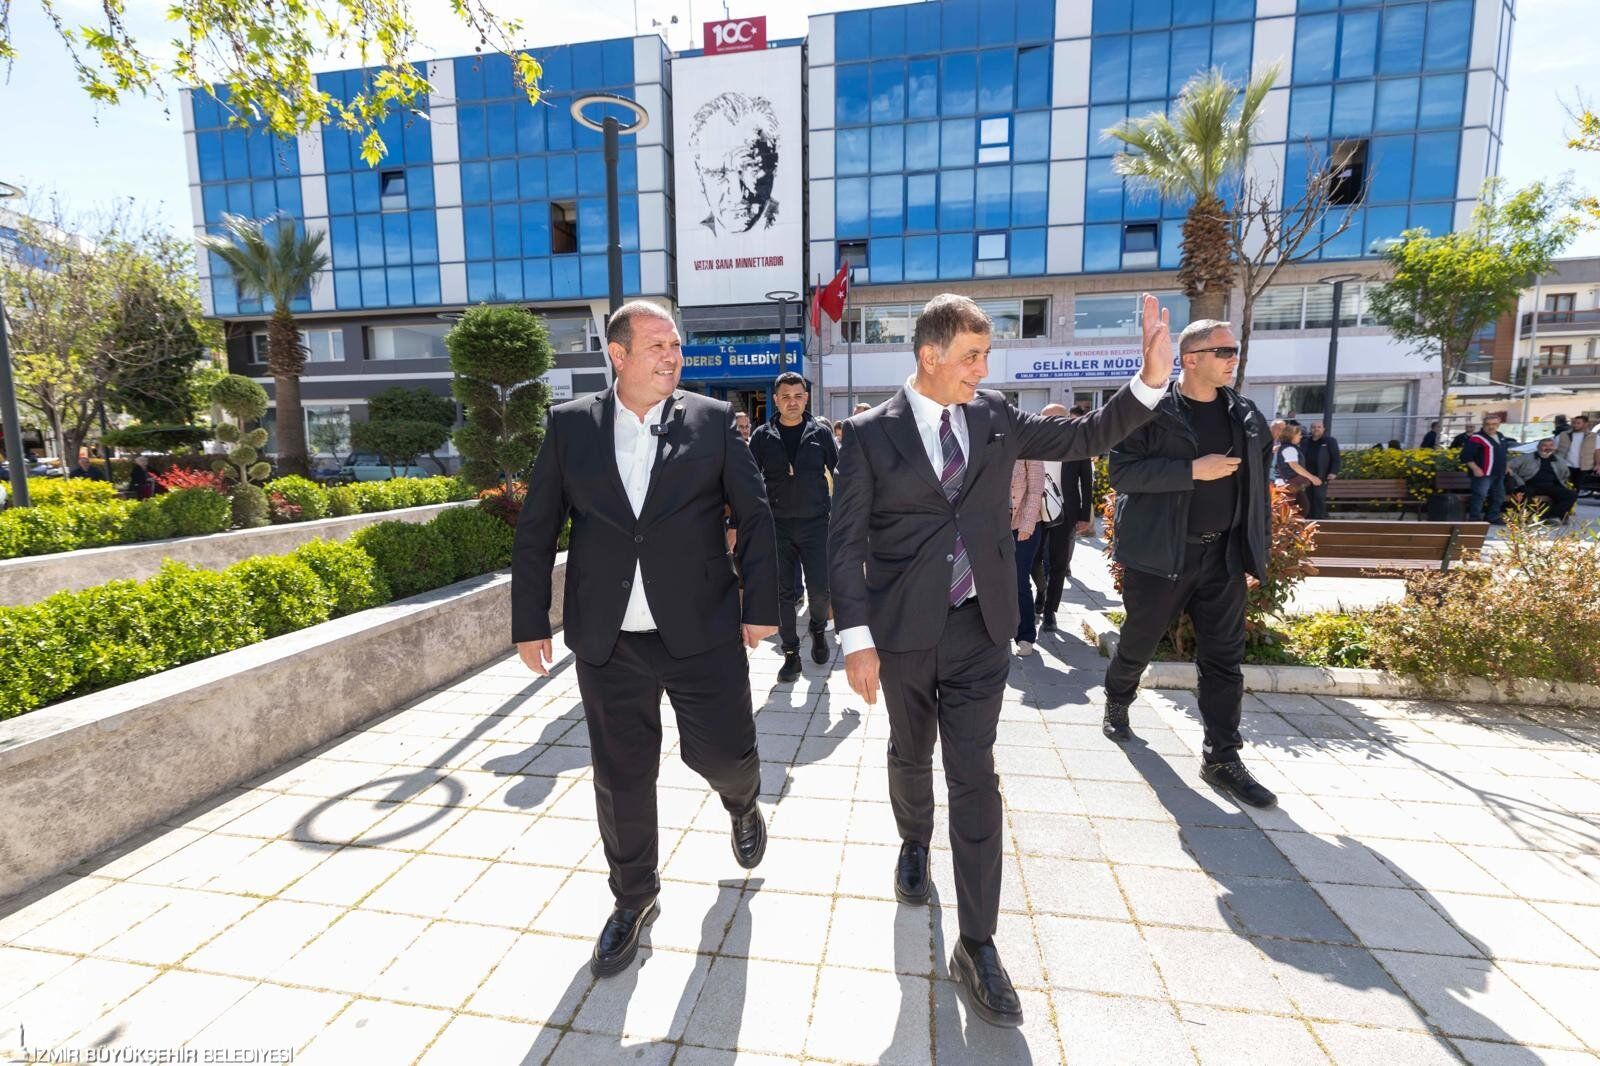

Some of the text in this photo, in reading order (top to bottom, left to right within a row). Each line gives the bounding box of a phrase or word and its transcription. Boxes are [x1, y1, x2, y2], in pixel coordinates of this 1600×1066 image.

[694, 255, 784, 271] VATAN SANA MINNETTARDIR
[1033, 358, 1099, 371] GELİRLER
